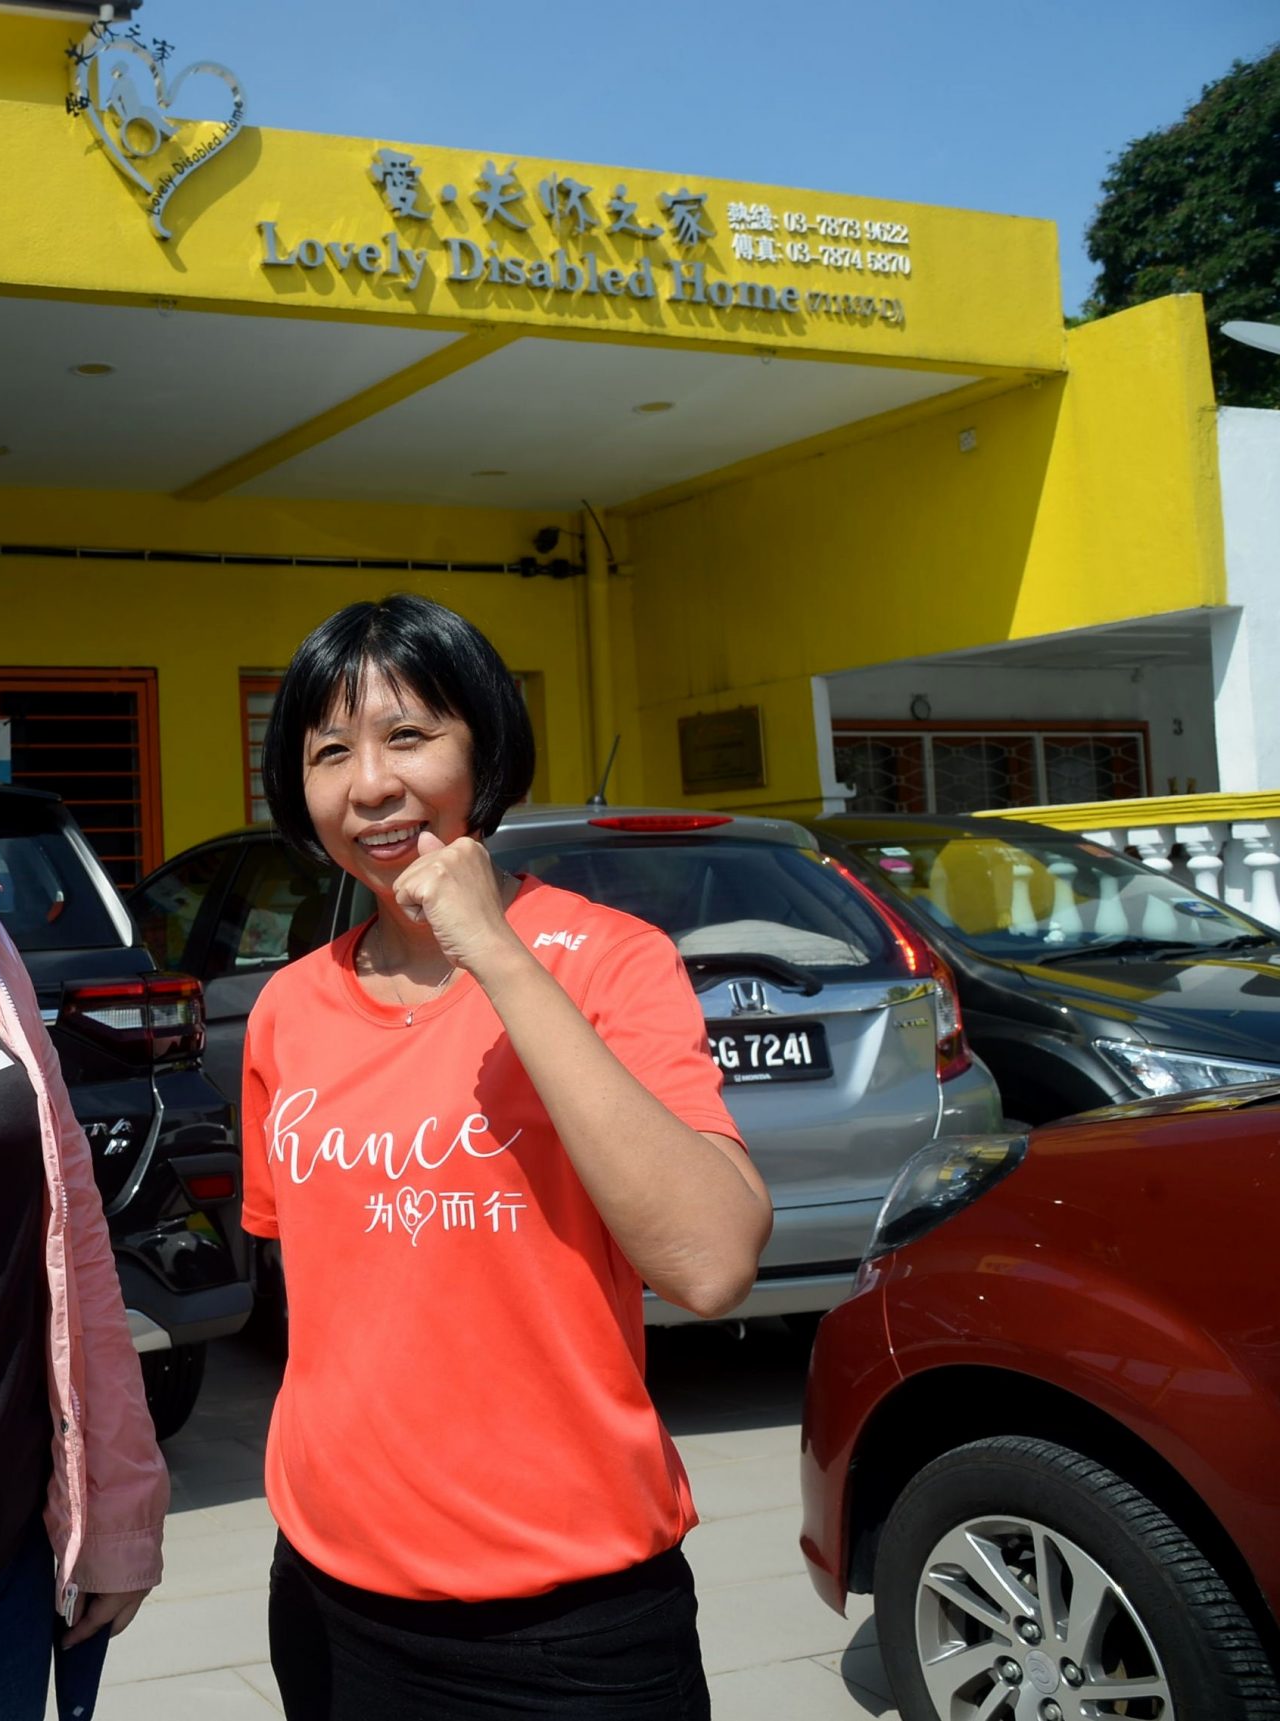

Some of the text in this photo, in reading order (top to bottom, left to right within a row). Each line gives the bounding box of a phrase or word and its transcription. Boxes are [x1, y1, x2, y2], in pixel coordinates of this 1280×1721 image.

[171, 133, 222, 175] Disabled
[864, 219, 909, 244] 9622
[258, 221, 427, 291] Lovely
[443, 237, 656, 298] Disabled
[667, 260, 802, 313] Home
[744, 1032, 813, 1067] 7241
